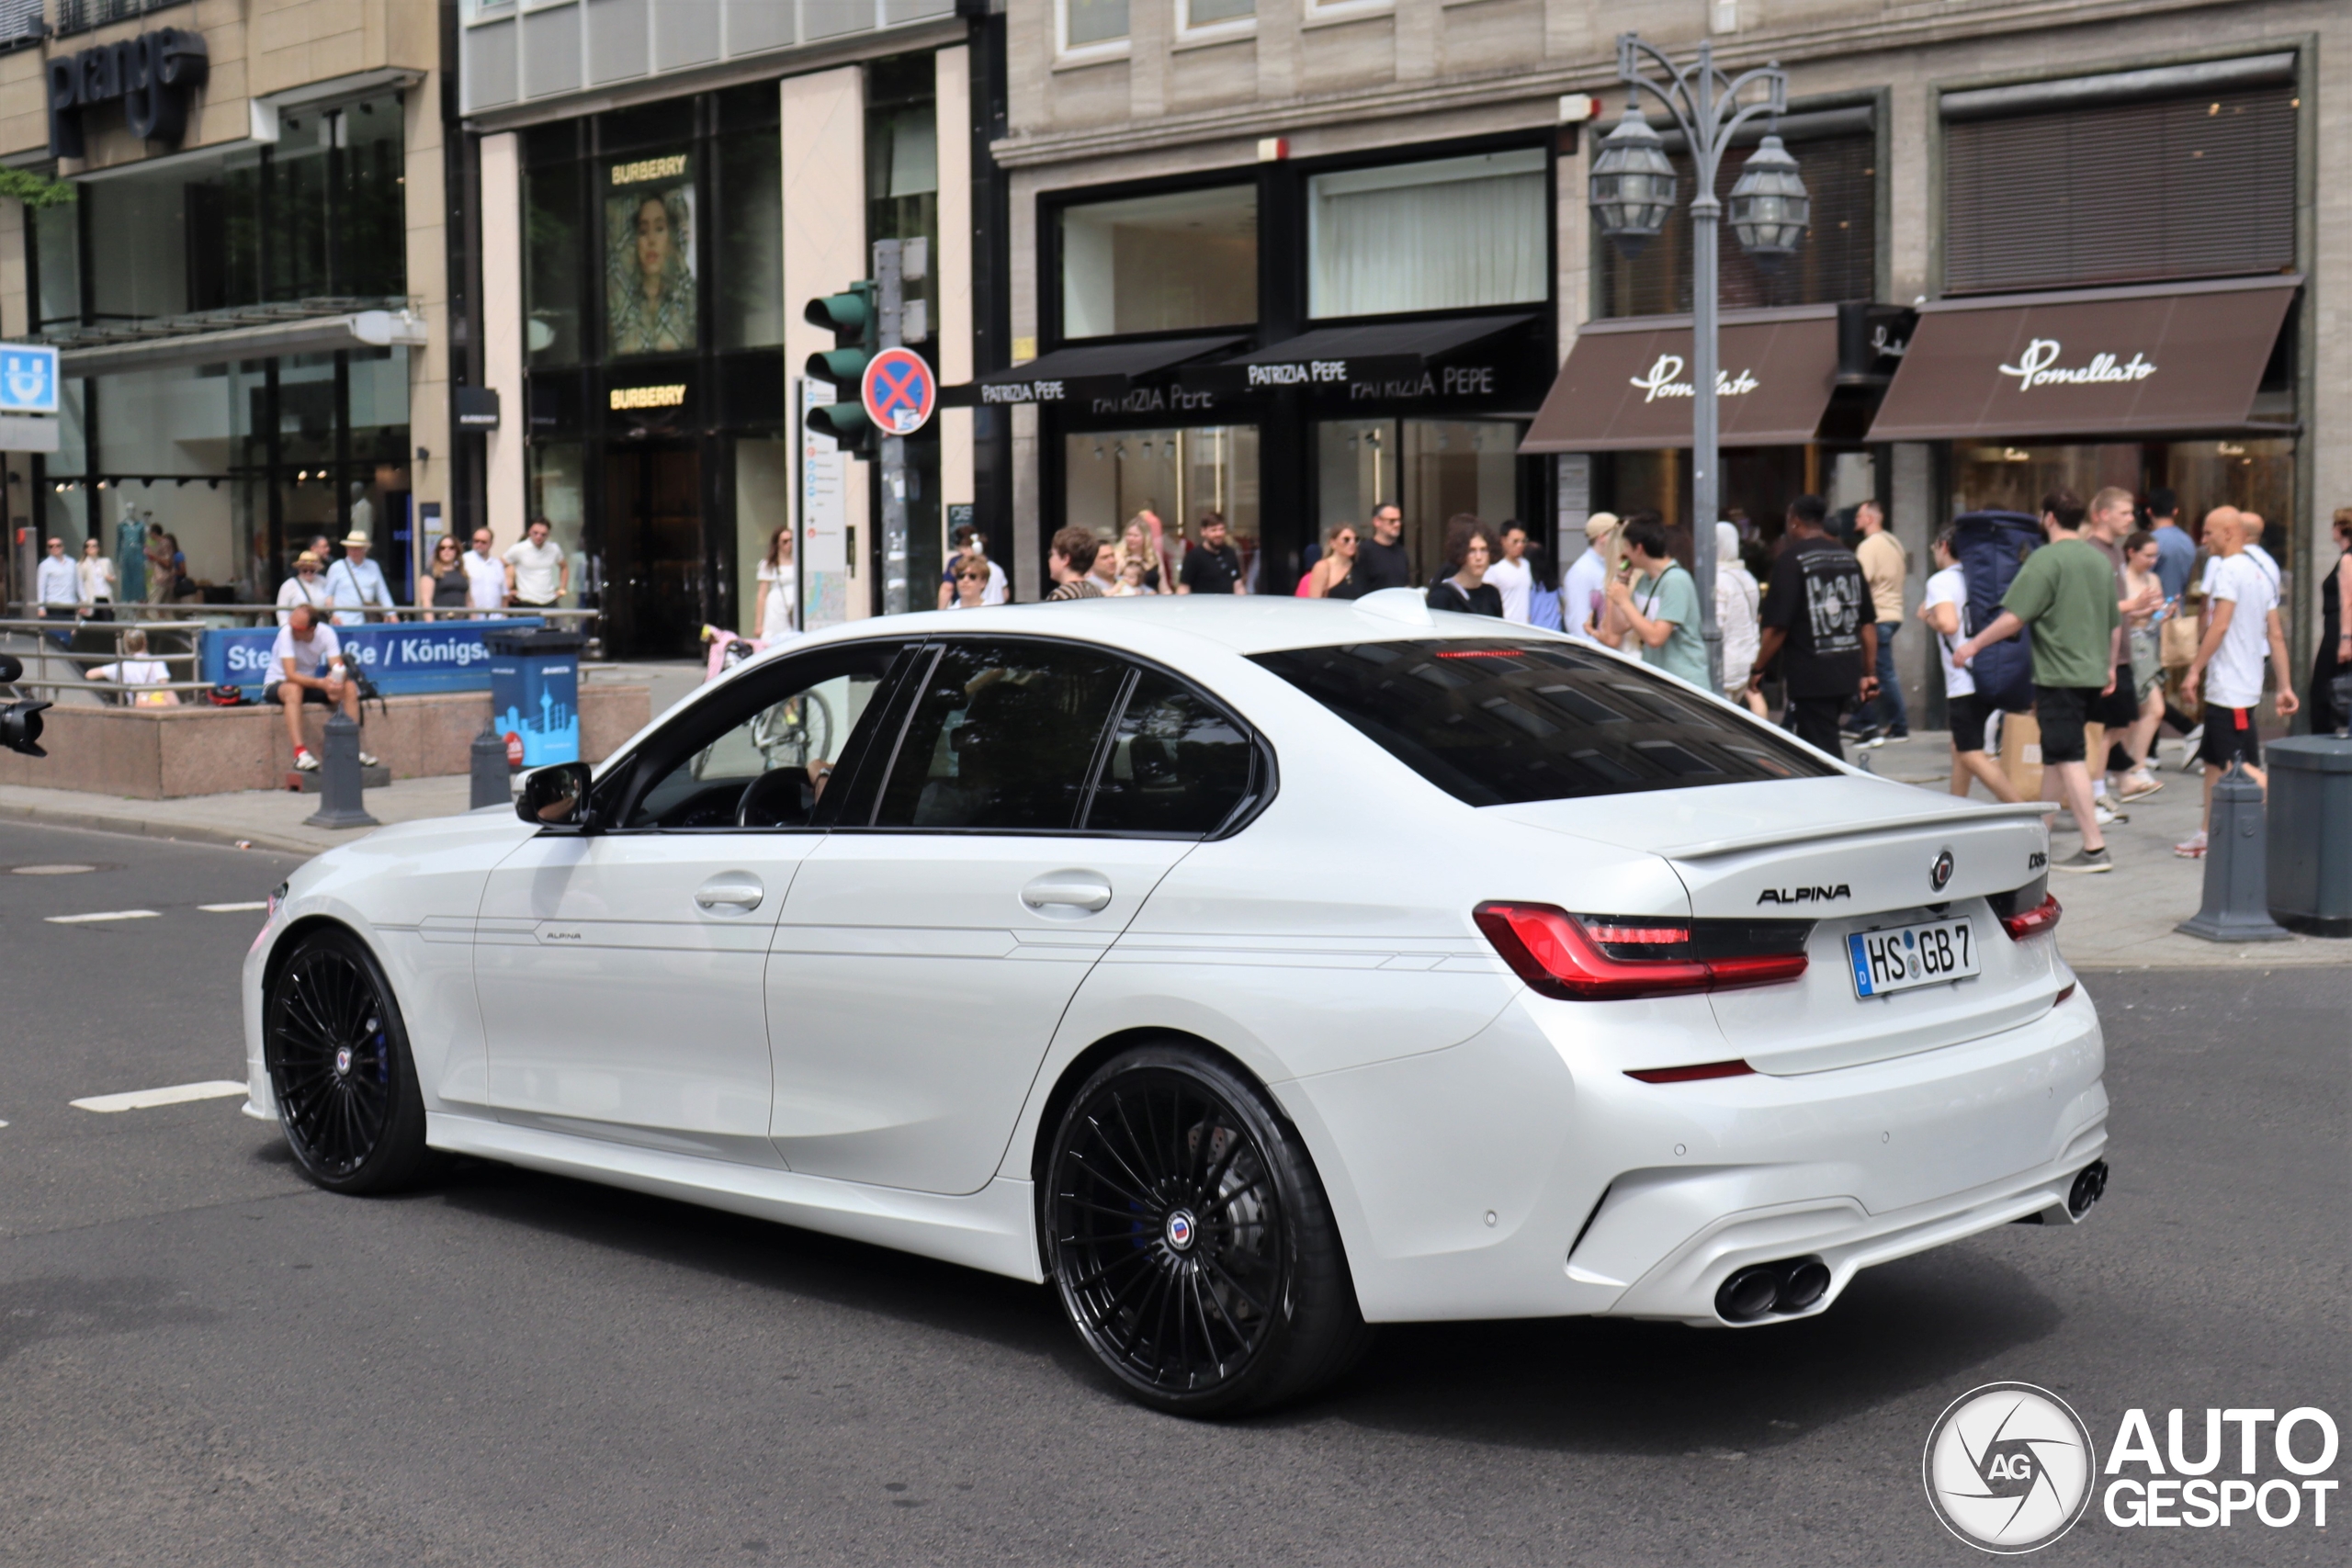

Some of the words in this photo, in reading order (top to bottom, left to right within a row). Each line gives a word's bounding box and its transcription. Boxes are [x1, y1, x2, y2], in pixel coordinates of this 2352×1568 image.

[612, 154, 687, 186] BURBERRY
[1248, 365, 1308, 385] PATRIZIA
[1311, 361, 1348, 382] PEPE
[1998, 338, 2157, 392] Pomellato
[981, 383, 1033, 403] PATRIZIA
[1034, 380, 1066, 400] PEPE
[1443, 367, 1494, 394] PEPE
[1630, 354, 1759, 403] Pomlato
[610, 384, 686, 410] BURBERRY
[1756, 884, 1851, 906] ALPINA
[1868, 935, 1905, 984] HS
[1919, 929, 1955, 975] GB
[1955, 924, 1970, 967] 7
[1859, 971, 1868, 985] D
